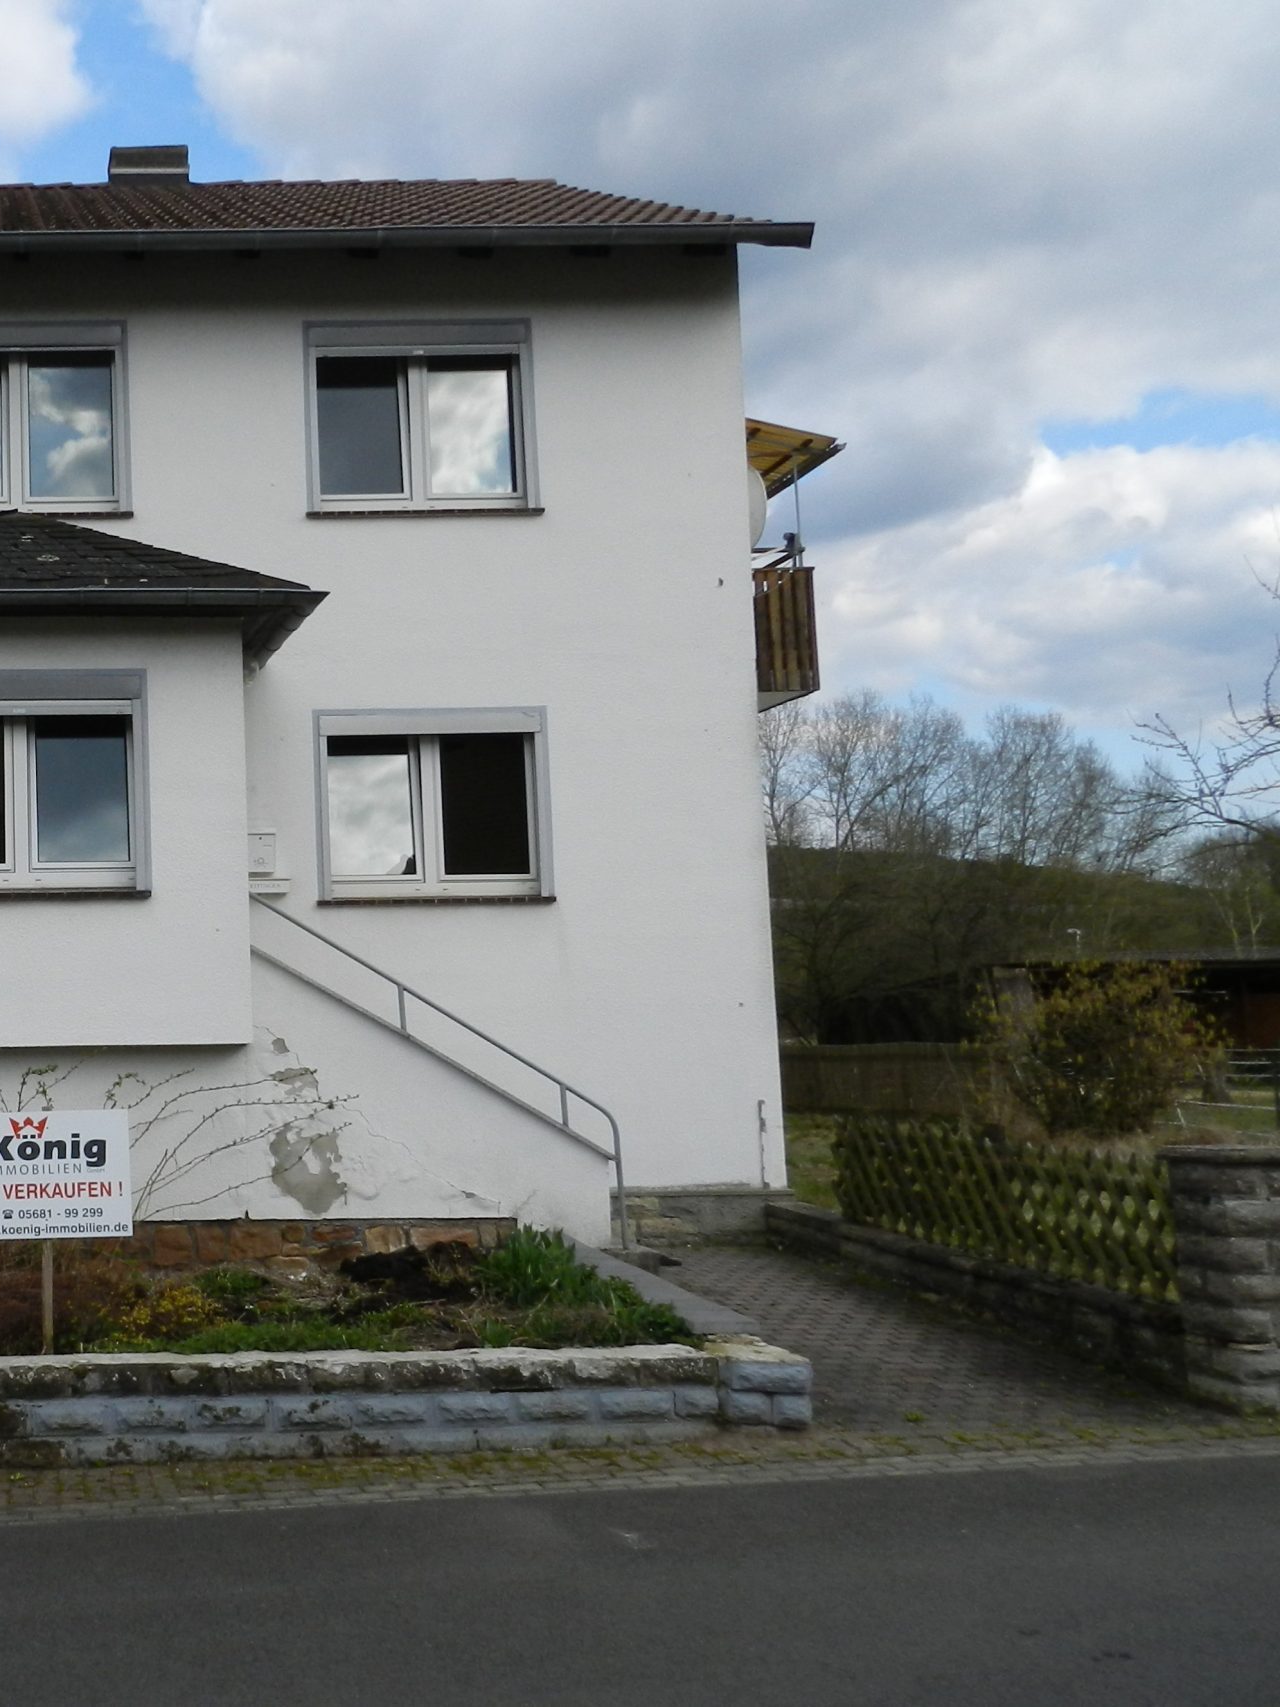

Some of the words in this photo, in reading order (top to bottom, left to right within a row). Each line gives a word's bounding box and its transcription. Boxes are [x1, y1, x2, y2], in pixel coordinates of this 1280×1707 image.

[2, 1181, 112, 1200] VERKAUFEN
[18, 1209, 53, 1219] 05681
[64, 1208, 79, 1218] 99
[82, 1207, 104, 1218] 299
